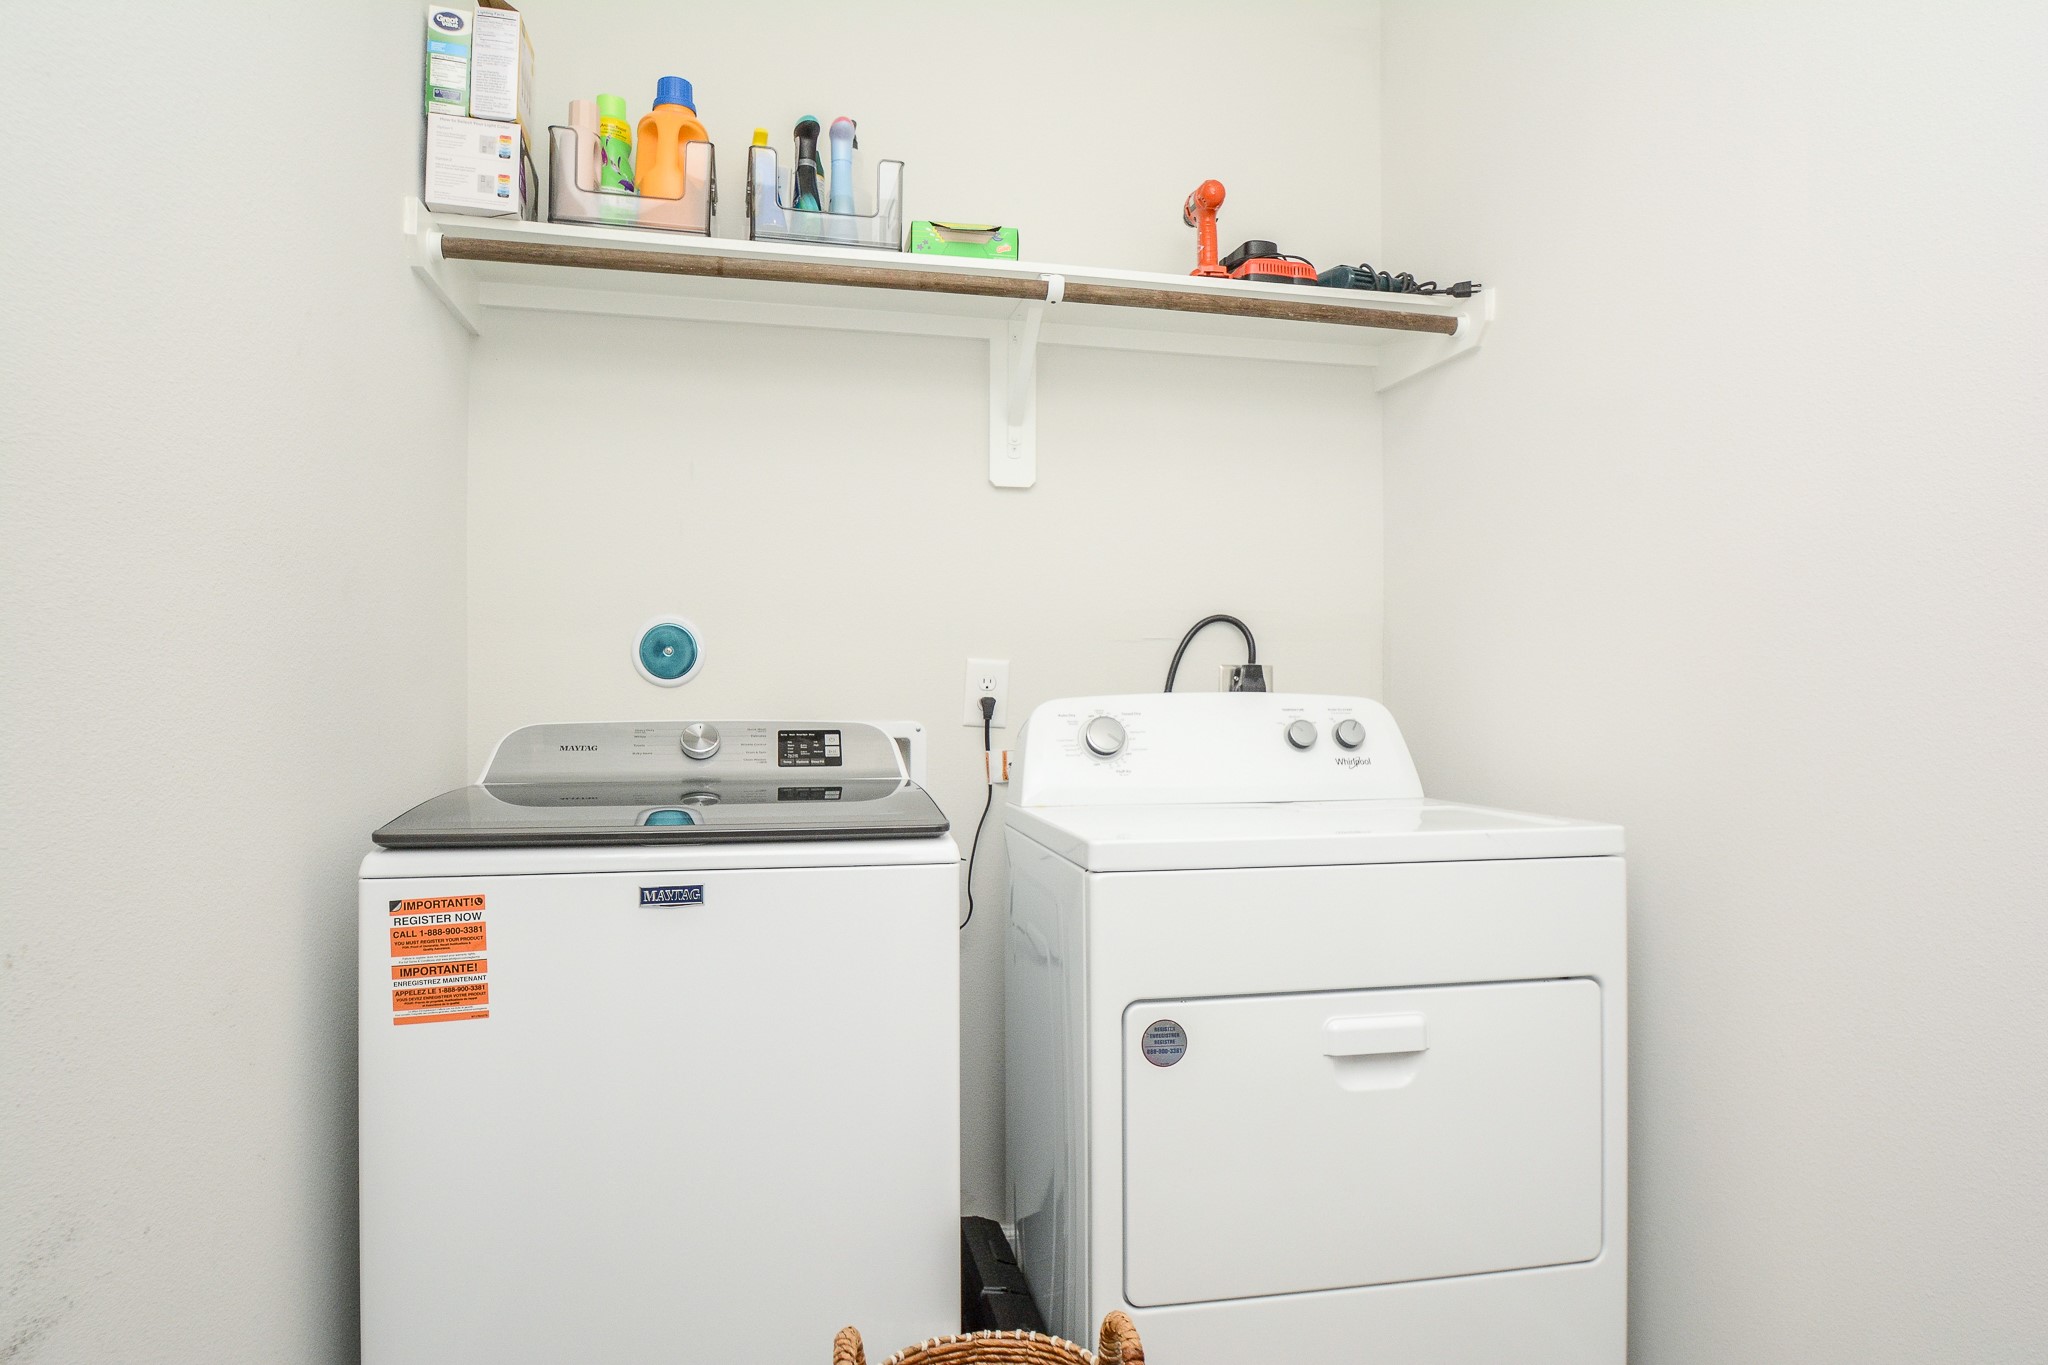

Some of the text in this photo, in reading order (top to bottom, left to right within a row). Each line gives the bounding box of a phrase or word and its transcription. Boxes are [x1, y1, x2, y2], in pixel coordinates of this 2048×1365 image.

[436, 14, 458, 24] Great
[1335, 757, 1371, 769] Whirlpool
[643, 889, 700, 902] MAYTAG
[404, 898, 473, 910] IMPORTANT!
[394, 912, 482, 926] REGISTER NOW
[393, 926, 483, 939] CALL 1-888-900-3381
[400, 963, 478, 977] IMPORTANTE!
[394, 975, 486, 987] ENREGISTREZ MAINTENANT
[395, 989, 426, 997] APPELEZ
[438, 985, 485, 994] 1-888-900-3381
